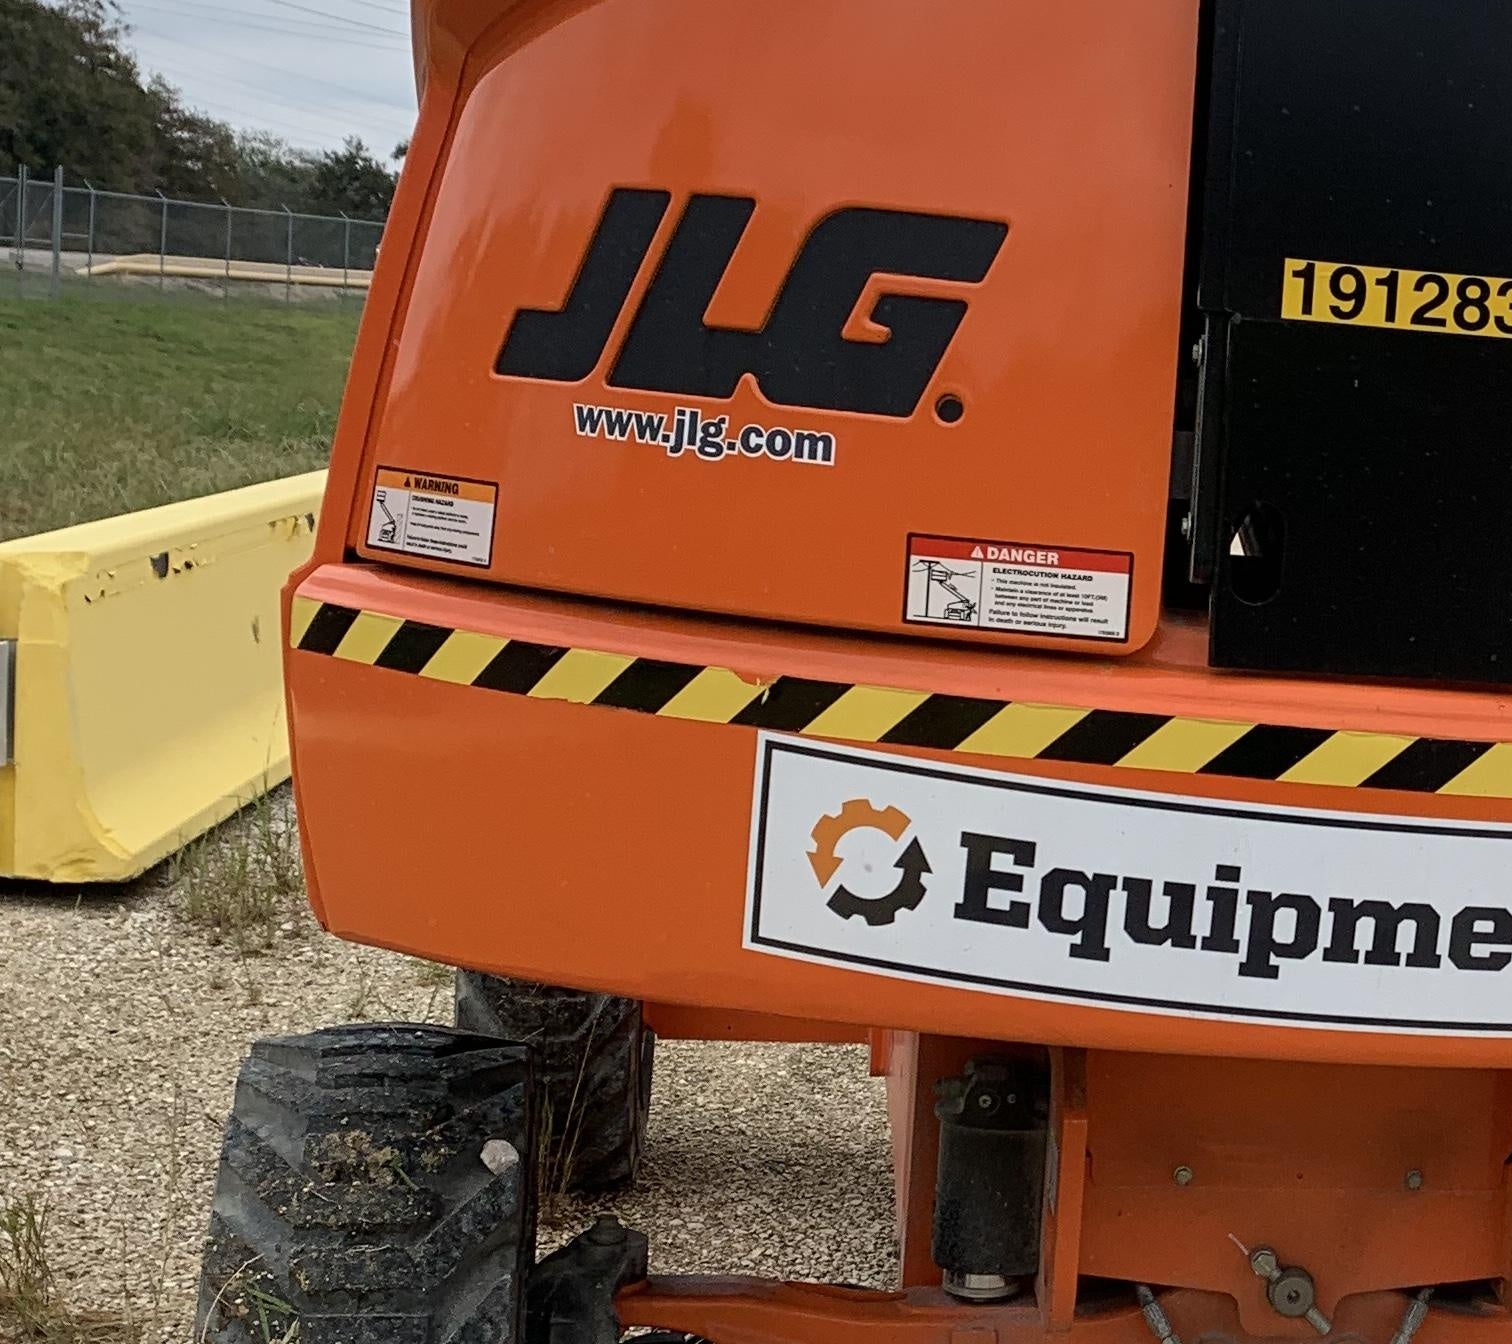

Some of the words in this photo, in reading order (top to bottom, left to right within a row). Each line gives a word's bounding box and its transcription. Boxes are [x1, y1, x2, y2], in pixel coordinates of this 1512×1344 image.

[574, 403, 834, 464] www.jlg.com
[414, 477, 459, 495] WARNING
[987, 546, 1059, 566] DANGER
[993, 568, 1058, 578] ELECTROCUTION
[1040, 614, 1076, 622] instructions
